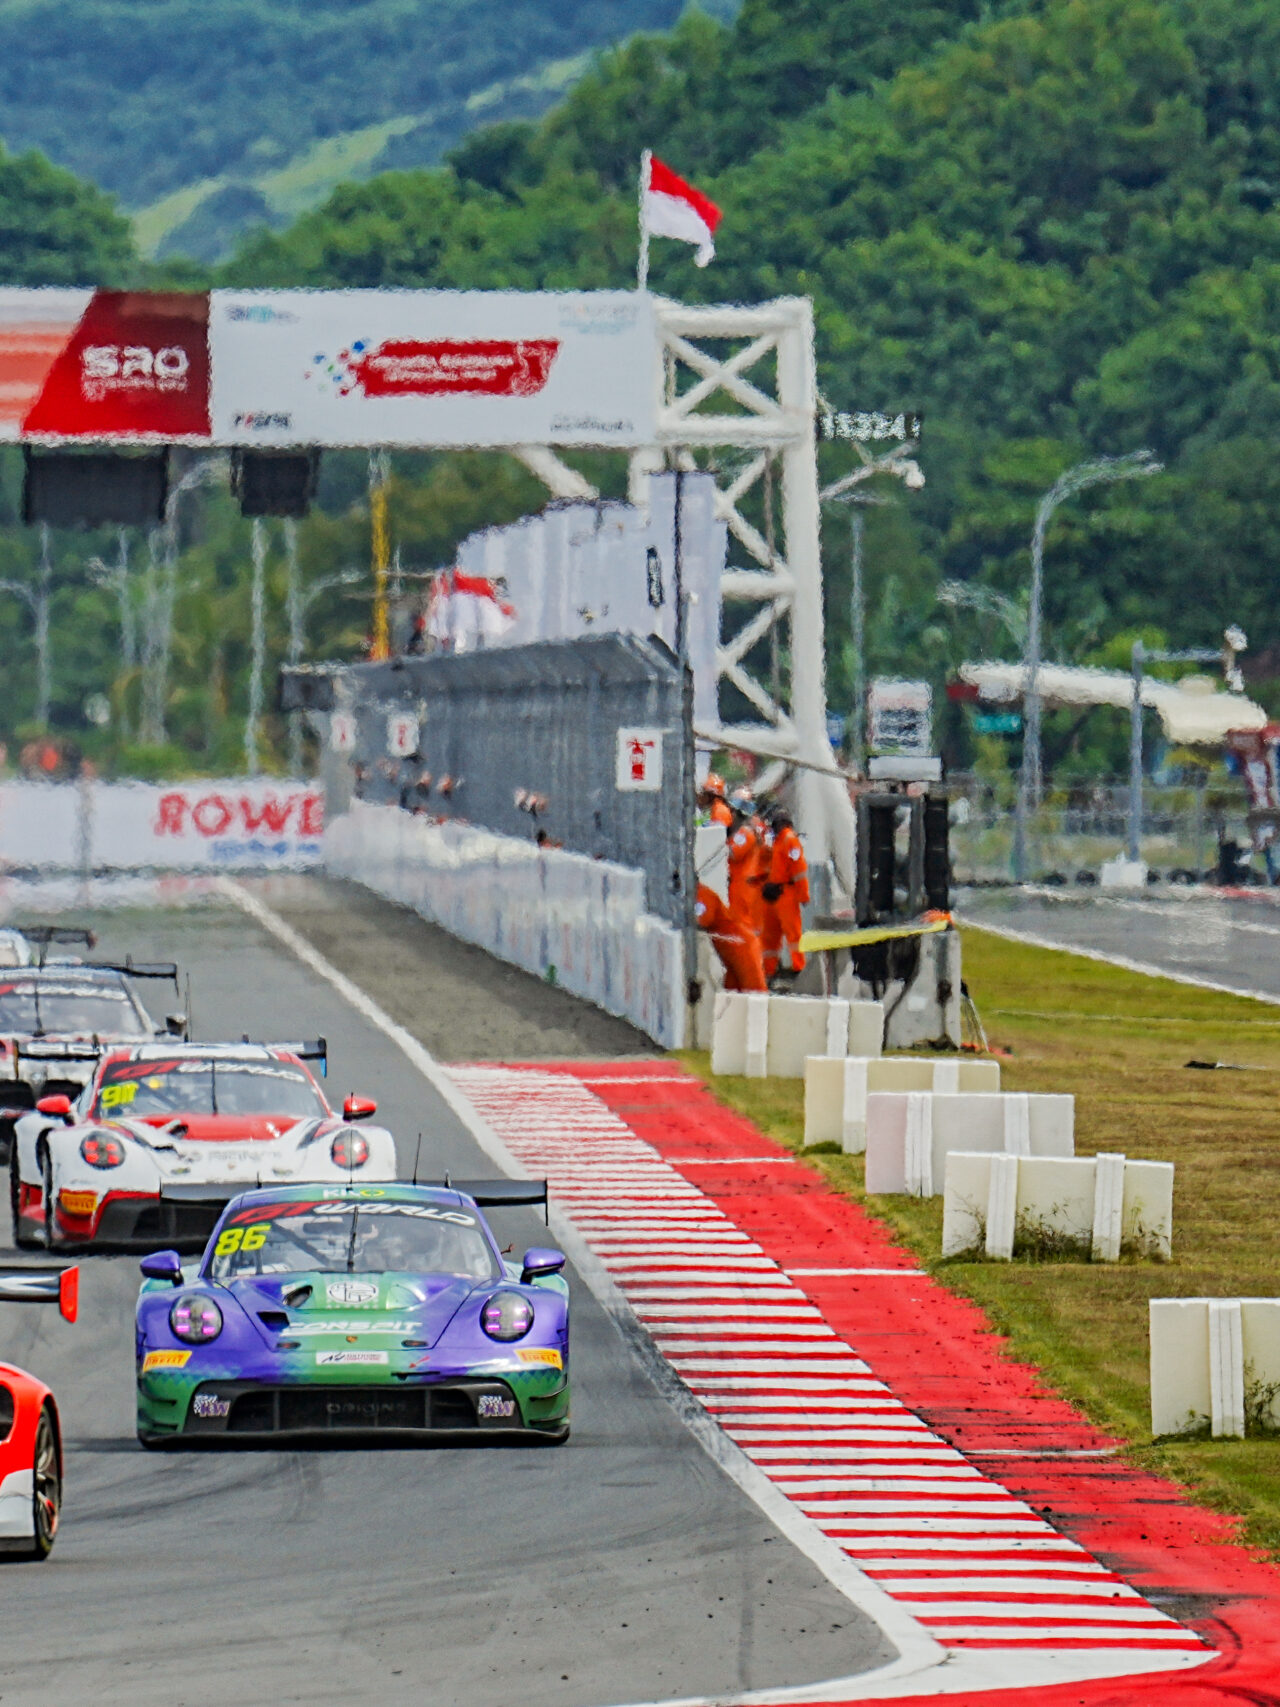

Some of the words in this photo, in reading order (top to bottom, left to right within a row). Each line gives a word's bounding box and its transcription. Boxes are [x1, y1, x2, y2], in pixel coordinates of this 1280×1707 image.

[153, 790, 325, 838] ROWE
[230, 1199, 344, 1224] GT
[312, 1202, 476, 1226] WORLD
[215, 1224, 272, 1256] 86
